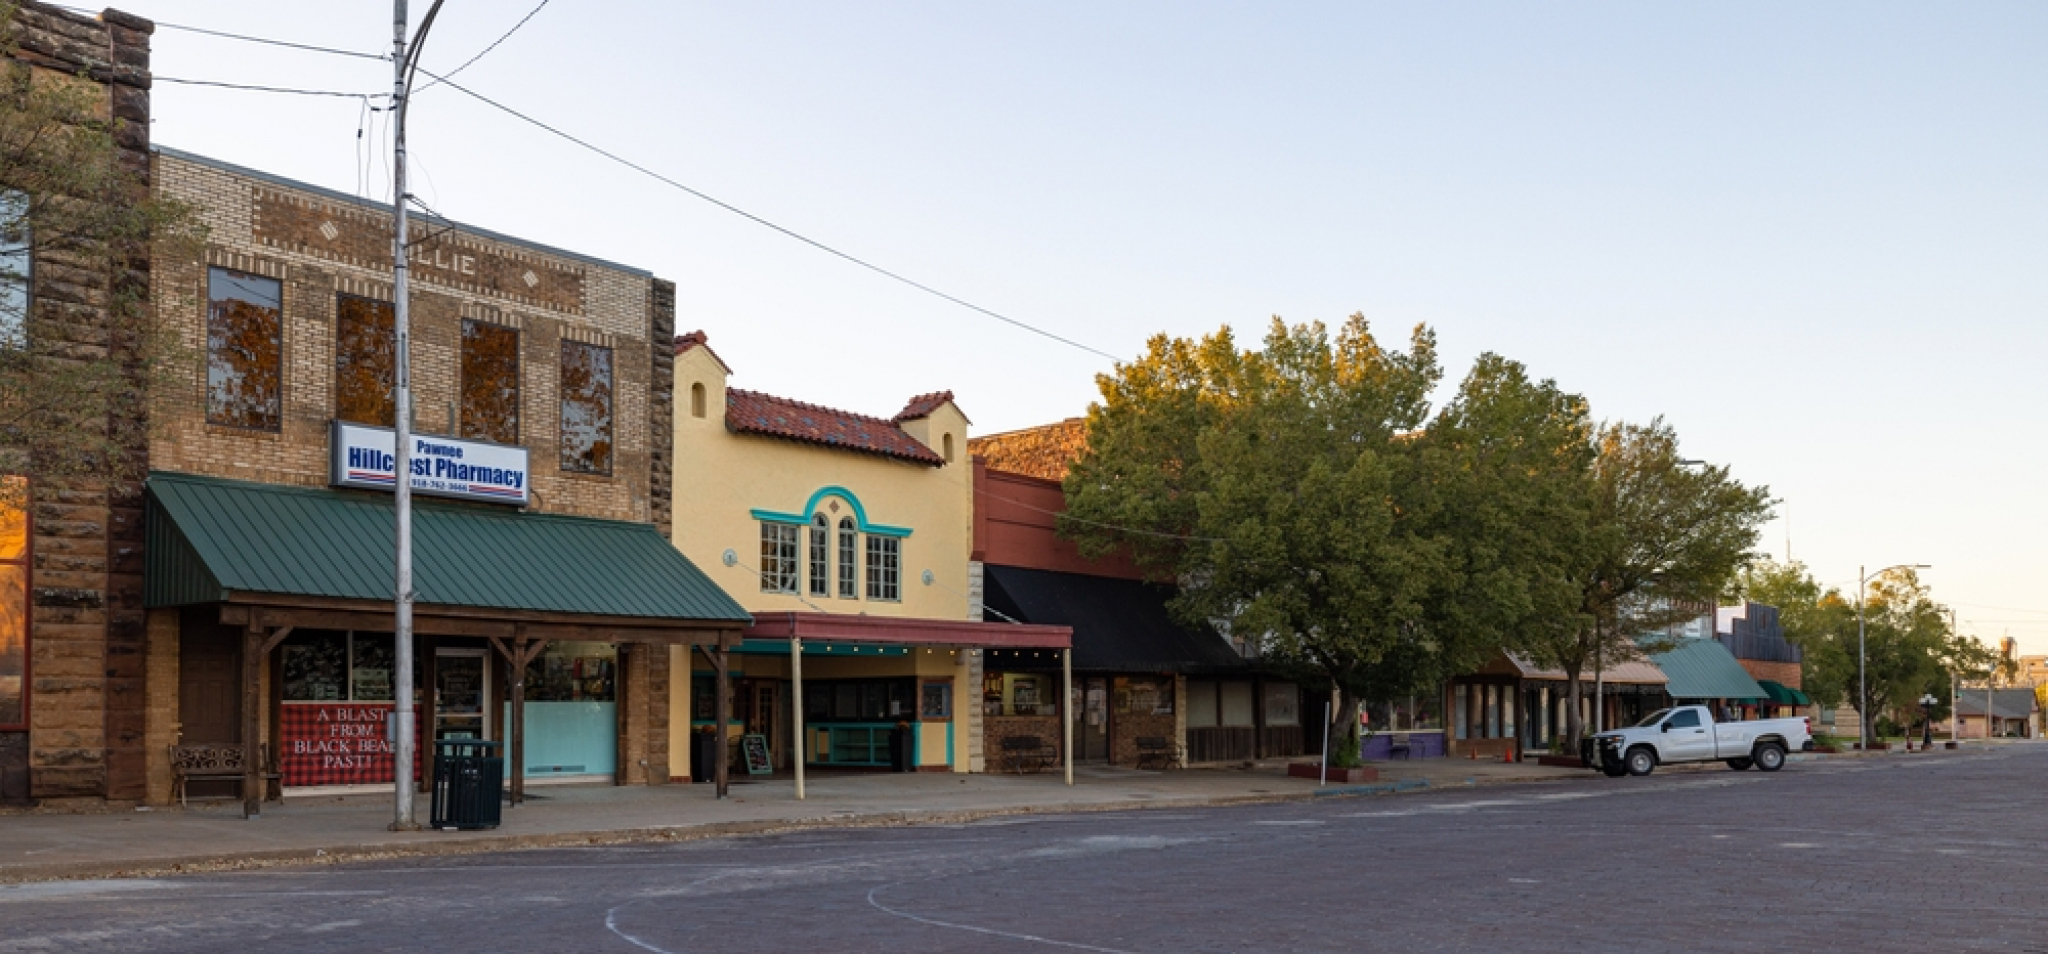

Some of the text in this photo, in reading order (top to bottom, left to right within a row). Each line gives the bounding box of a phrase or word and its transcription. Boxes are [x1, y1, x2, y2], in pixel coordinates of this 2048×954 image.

[391, 238, 475, 275] ILLIE
[417, 439, 463, 459] Pawnee
[348, 446, 523, 488] Hillcst Pharmacy
[317, 707, 388, 722] A BLAST
[330, 724, 374, 738] FROM
[294, 738, 351, 754] BLACK
